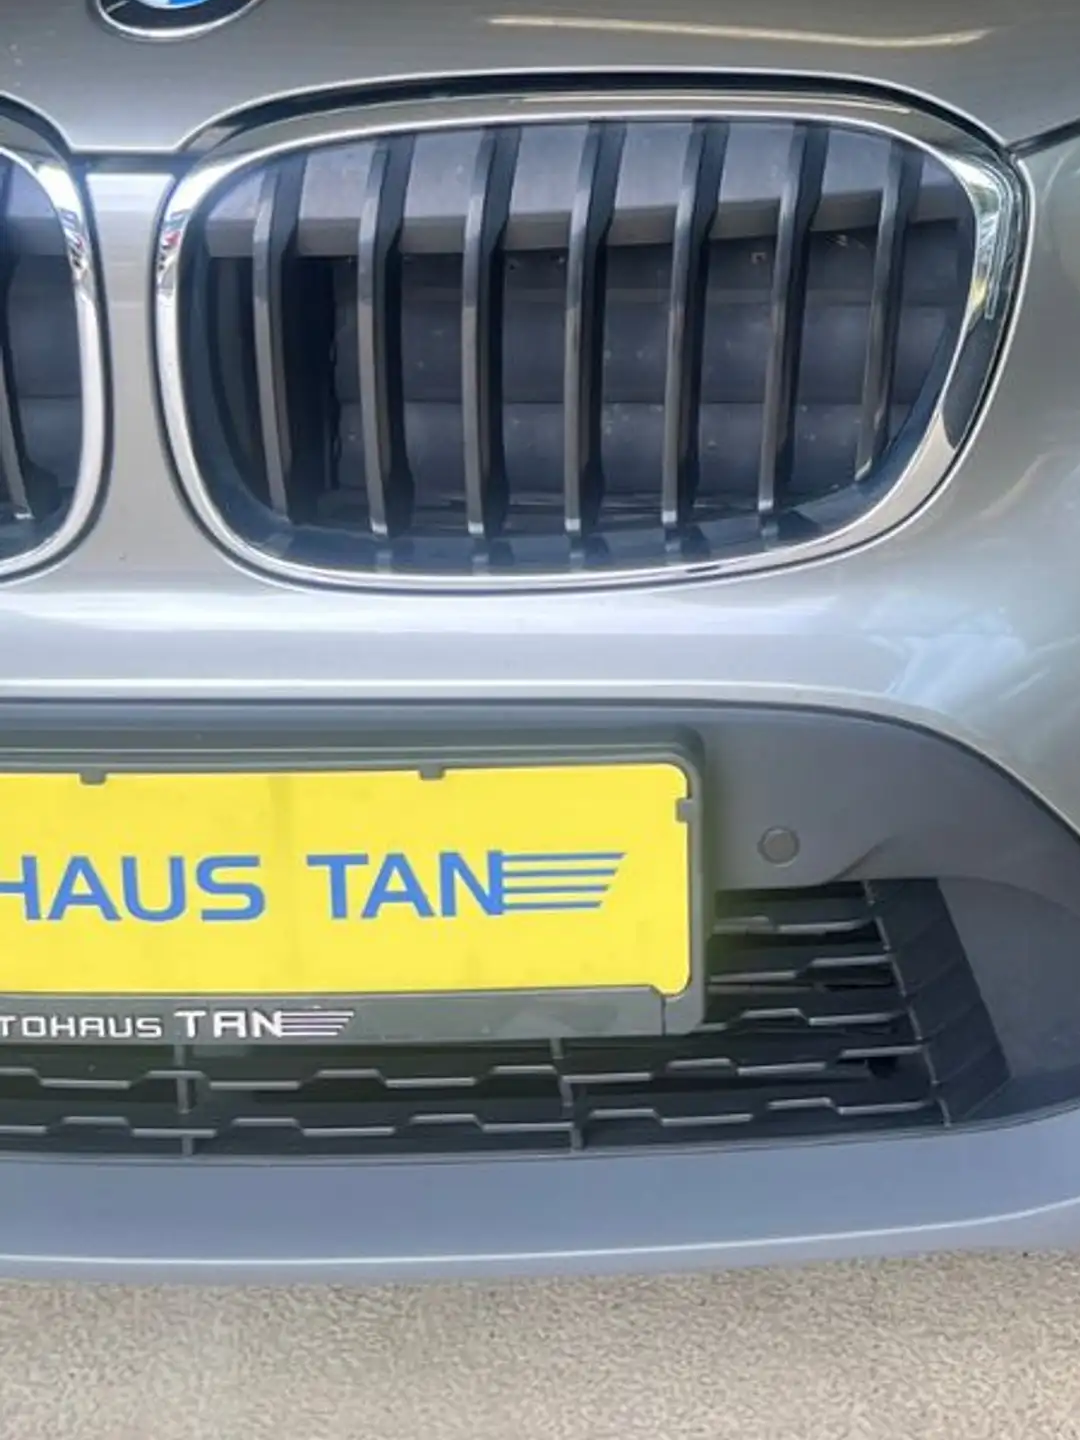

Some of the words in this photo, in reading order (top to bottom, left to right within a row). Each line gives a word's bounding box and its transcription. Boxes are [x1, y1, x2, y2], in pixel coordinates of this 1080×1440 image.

[0, 854, 266, 922] HAUS
[306, 850, 505, 920] TAN
[0, 1014, 162, 1038] TOHAUS
[173, 1010, 283, 1038] TAN
